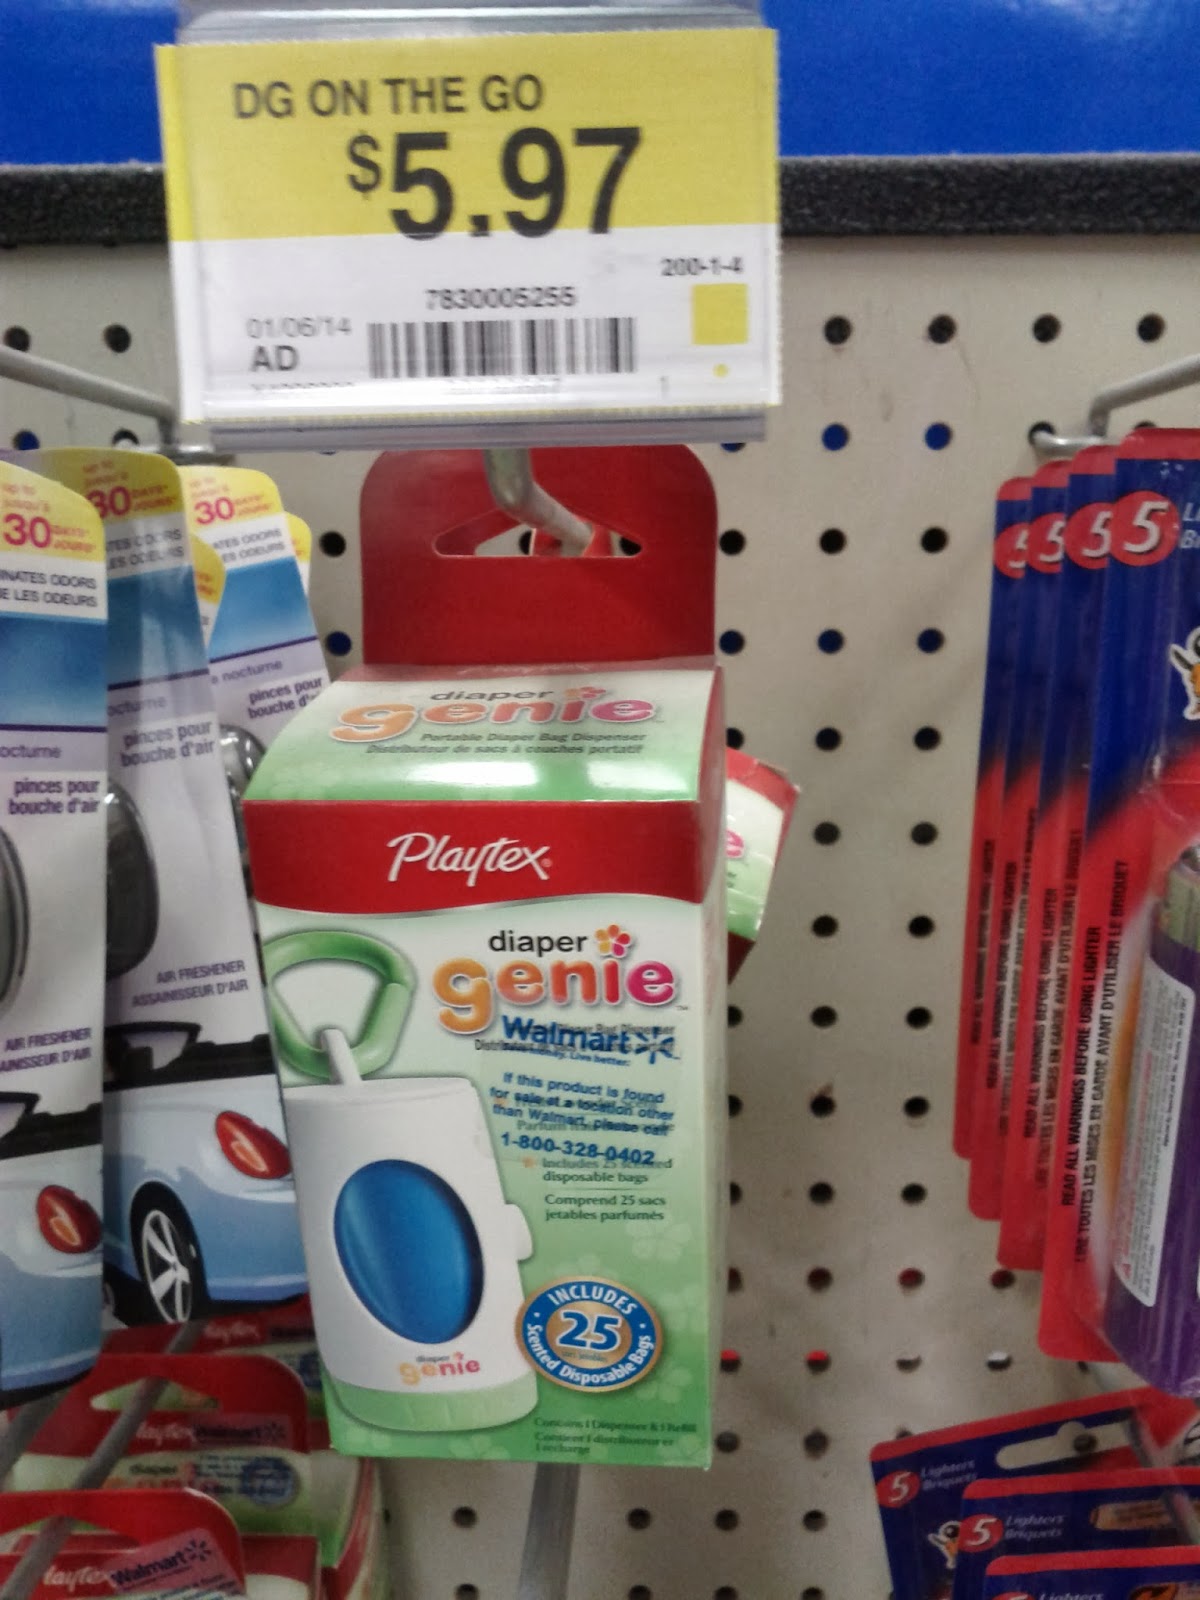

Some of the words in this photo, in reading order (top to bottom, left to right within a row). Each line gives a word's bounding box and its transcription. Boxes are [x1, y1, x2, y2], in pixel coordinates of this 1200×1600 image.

[233, 81, 295, 119] DG
[308, 78, 371, 117] ON
[383, 76, 468, 114] THE
[480, 74, 544, 113] GO
[347, 126, 643, 241] $5.97
[661, 256, 744, 277] 200-1-4
[425, 286, 577, 311] 7830005255
[249, 343, 300, 373] AD
[194, 496, 235, 525] 30
[3, 513, 52, 548] 30
[1082, 511, 1112, 558] 5
[1123, 501, 1170, 553] 5
[50, 573, 97, 590] ODORS
[13, 590, 39, 602] LES
[42, 591, 98, 608] ODEURS
[222, 660, 283, 681] nocturne
[248, 685, 291, 706] pinces
[294, 677, 322, 695] pour
[430, 690, 554, 701] diaper
[247, 699, 295, 719] bouche
[330, 699, 656, 743] genie
[123, 728, 174, 751] pinces
[178, 720, 212, 742] pour
[365, 744, 451, 754] Distributeur
[452, 744, 472, 754] de
[474, 745, 508, 754] sacs
[525, 744, 584, 754] couches
[588, 743, 643, 756] portatif
[421, 732, 482, 742] Portable
[486, 732, 534, 743] Diaper
[538, 732, 569, 743] Bag
[571, 732, 648, 743] Dispenser
[120, 746, 176, 768] bouche
[180, 740, 215, 757] d'air
[14, 777, 62, 798] pinces
[67, 780, 100, 798] pour
[8, 798, 64, 815] bouche
[67, 797, 100, 814] d'air
[387, 832, 549, 887] Playtex
[1109, 859, 1129, 918] BRIQUET
[489, 930, 588, 957] diaper
[1107, 922, 1121, 937] LE
[1082, 926, 1101, 981] LIGHTER
[157, 970, 177, 984] AIR
[178, 959, 246, 980] FRESHENER
[1100, 940, 1121, 1010] D'UTILISER
[217, 978, 249, 996] D'AIR
[432, 957, 677, 1035] genie
[1078, 984, 1095, 1023] USING
[5, 1037, 25, 1052] AIR
[28, 1027, 92, 1048] FRESHENER
[502, 1015, 630, 1054] Walmart
[1097, 1013, 1113, 1057] AVANT
[62, 1047, 92, 1063] D'AIR
[1073, 1028, 1090, 1075] BEFORE
[503, 1072, 513, 1083] If
[517, 1074, 544, 1088] this
[547, 1080, 602, 1096] product
[607, 1086, 619, 1098] is
[622, 1088, 665, 1103] found
[1091, 1060, 1109, 1100] GARDE
[490, 1086, 509, 1098] for
[514, 1092, 541, 1104] sale
[577, 1099, 632, 1115] location
[638, 1108, 674, 1121] other
[493, 1103, 523, 1117] than
[593, 1119, 638, 1133] please
[1067, 1079, 1086, 1145] WARNINGS
[1089, 1105, 1102, 1120] EN
[501, 1131, 656, 1166] 1-800-328-0402
[1085, 1124, 1100, 1161] MISES
[542, 1158, 598, 1169] Includes
[1065, 1148, 1079, 1171] ALL
[543, 1171, 614, 1184] disposable
[617, 1172, 649, 1185] bags
[1061, 1174, 1077, 1206] READ
[1082, 1165, 1097, 1186] LES
[544, 1194, 617, 1208] Comprend
[620, 1195, 635, 1206] 25
[639, 1197, 667, 1206] sacs
[1079, 1189, 1094, 1232] TOUTES
[545, 1210, 597, 1222] jetables
[600, 1209, 665, 1223] parfumés
[547, 1285, 638, 1315] INCLUDES
[557, 1309, 623, 1353] 25
[526, 1322, 562, 1371] Scented
[559, 1362, 638, 1386] Disposable
[628, 1334, 655, 1366] Bags
[399, 1358, 481, 1387] genie
[135, 1421, 198, 1447] laytex
[921, 1460, 975, 1479] Lighters
[888, 1471, 912, 1504] 5
[965, 1517, 998, 1546] 5
[1005, 1528, 1062, 1541] Briquets
[1006, 1514, 1065, 1528] Lighters
[43, 1565, 118, 1592] laytex
[110, 1550, 186, 1585] Walmart
